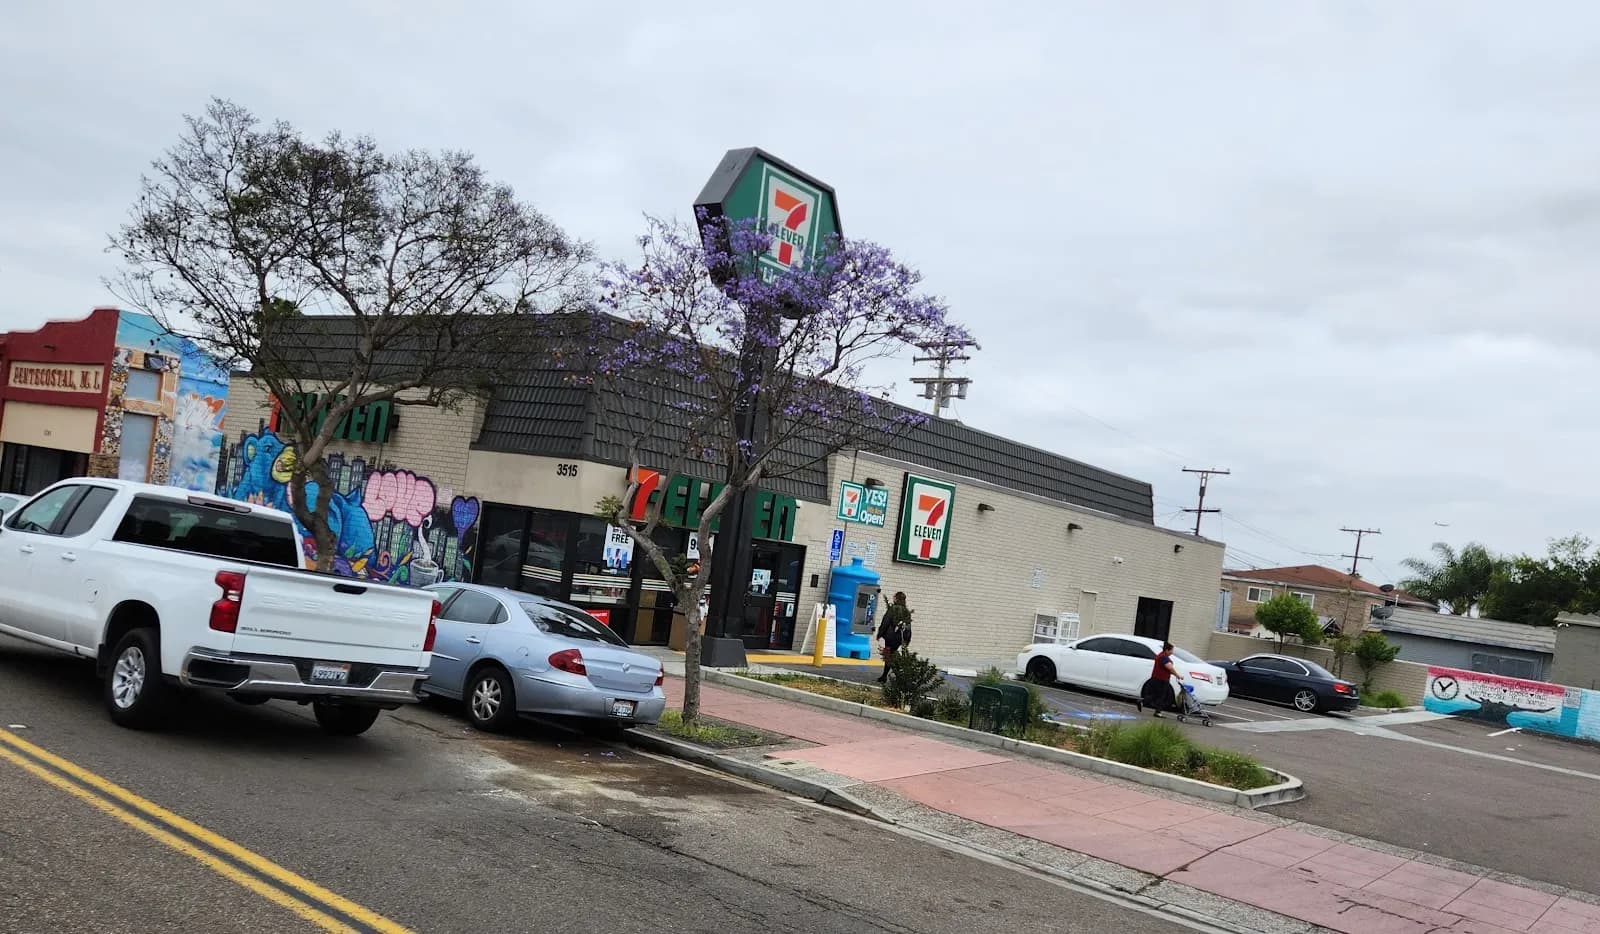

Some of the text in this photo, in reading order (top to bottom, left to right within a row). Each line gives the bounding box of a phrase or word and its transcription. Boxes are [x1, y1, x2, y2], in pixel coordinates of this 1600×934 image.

[13, 366, 76, 390] PENTECOSTAL,
[556, 463, 578, 477] 3515
[865, 488, 887, 507] YES!
[860, 511, 885, 526] Open!
[611, 533, 629, 544] FREE
[690, 538, 699, 551] 9
